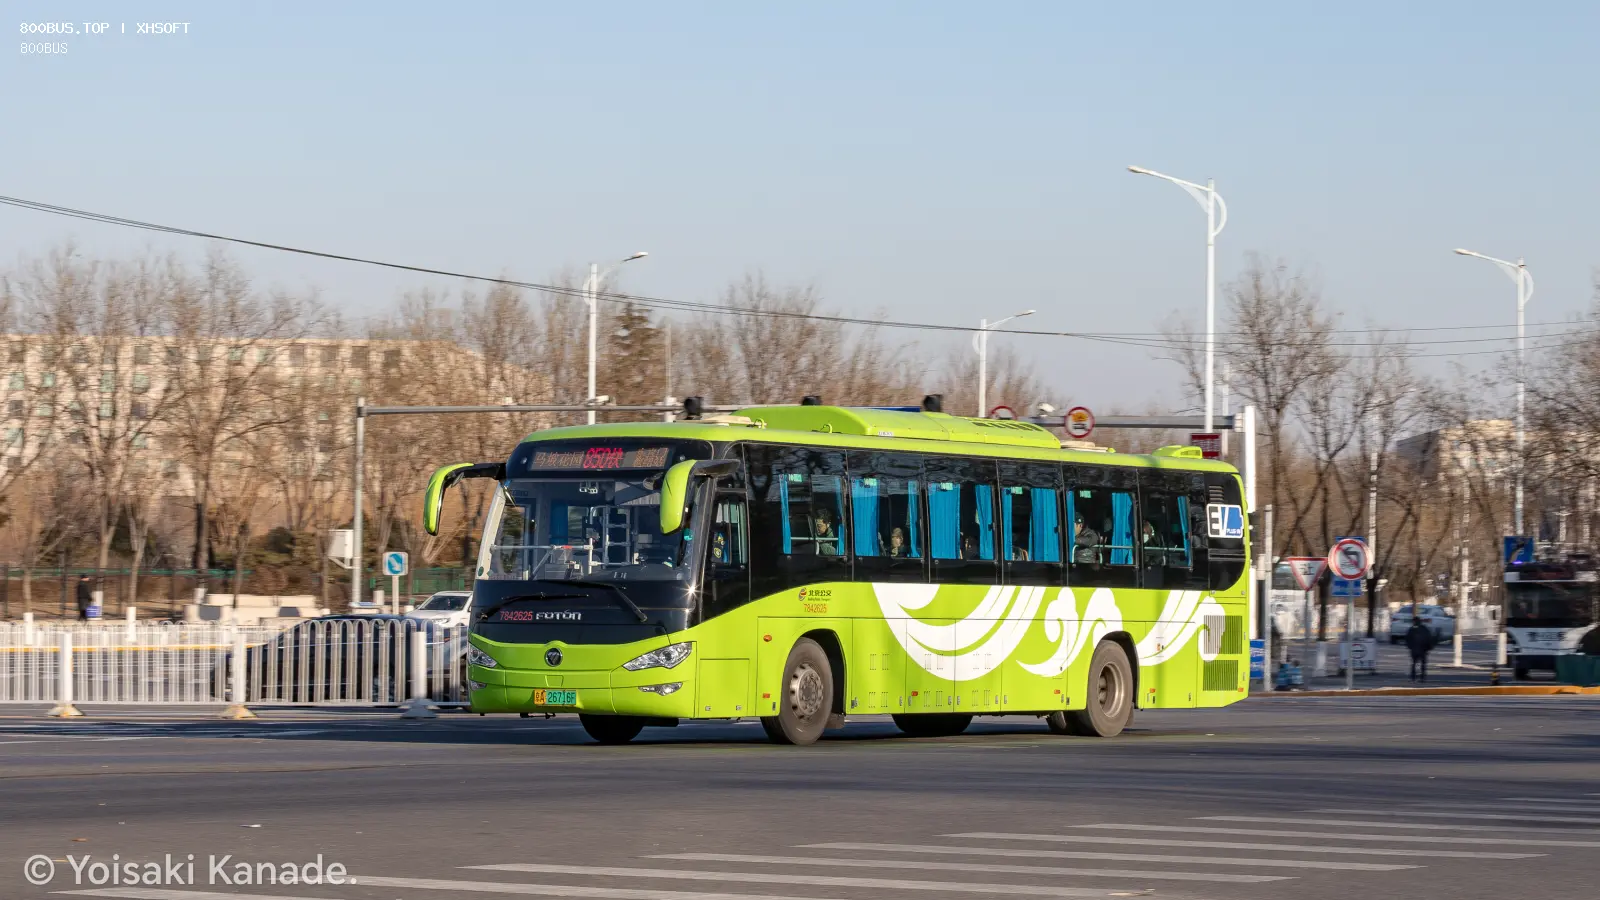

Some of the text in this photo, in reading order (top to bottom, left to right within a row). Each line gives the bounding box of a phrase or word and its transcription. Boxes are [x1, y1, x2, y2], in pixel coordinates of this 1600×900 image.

[808, 589, 832, 597] 北京公交
[803, 603, 828, 613] 7842625
[499, 610, 533, 621] 7842625
